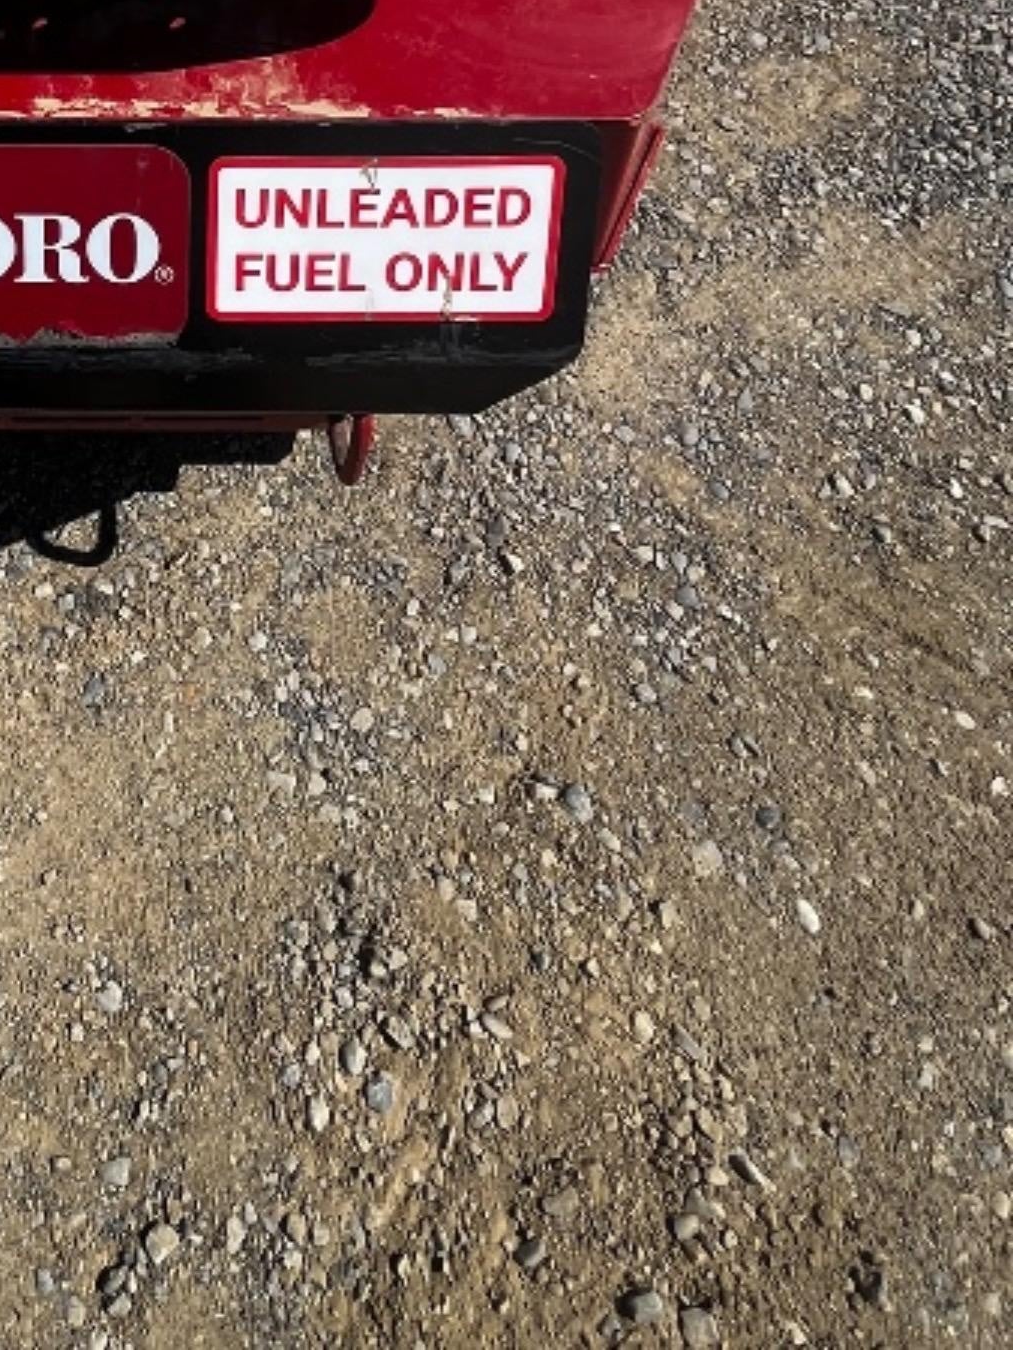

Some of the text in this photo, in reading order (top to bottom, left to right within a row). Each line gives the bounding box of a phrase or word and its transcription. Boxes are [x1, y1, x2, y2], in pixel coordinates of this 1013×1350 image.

[234, 188, 532, 229] UNLEADED
[234, 252, 529, 293] FUEL ONLY
